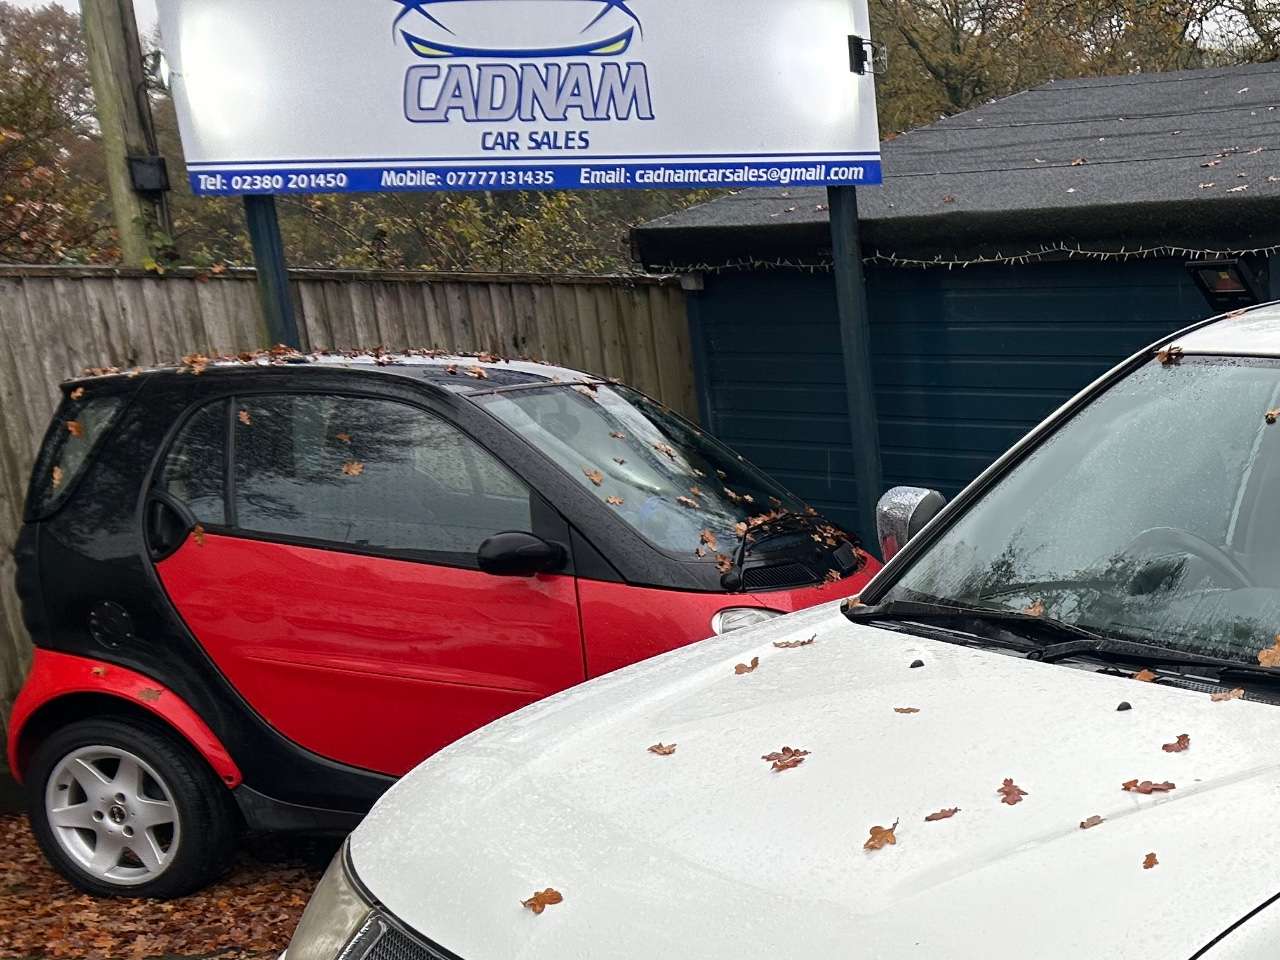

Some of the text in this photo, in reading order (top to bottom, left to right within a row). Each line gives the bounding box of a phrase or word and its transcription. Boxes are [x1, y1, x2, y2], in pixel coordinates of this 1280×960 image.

[403, 62, 655, 122] CADNAM
[480, 130, 590, 150] CAR SALES
[198, 172, 348, 190] Tel: 02380 201450
[380, 169, 555, 187] Mobile: 07777131435
[579, 163, 864, 184] Email: cadnamcarsales@gmail.com
